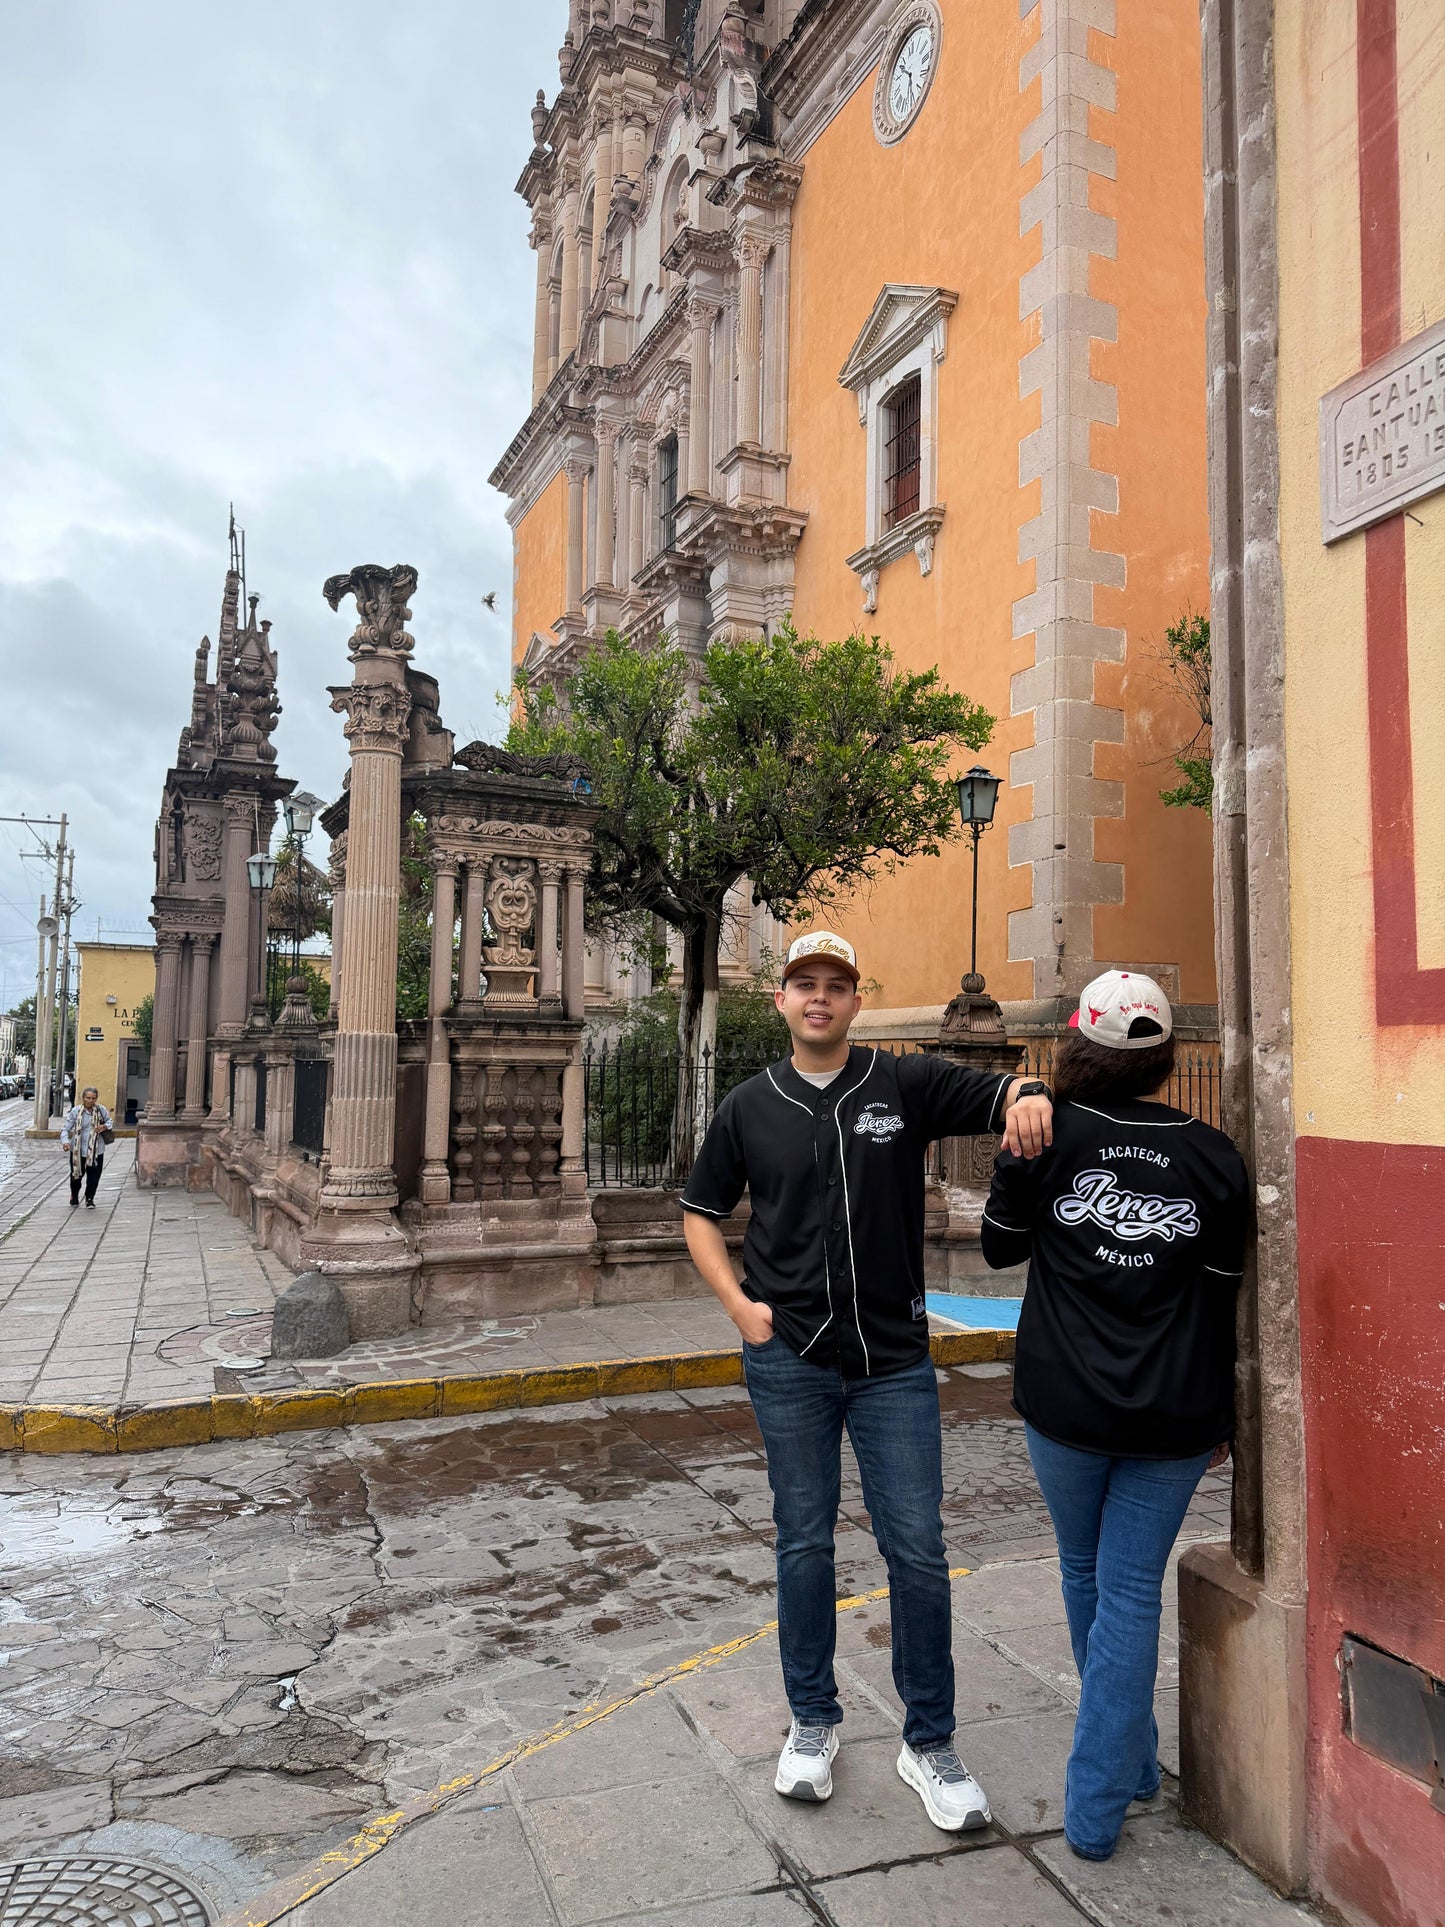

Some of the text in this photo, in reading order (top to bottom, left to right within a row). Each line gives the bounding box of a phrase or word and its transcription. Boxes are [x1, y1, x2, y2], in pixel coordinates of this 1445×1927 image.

[1368, 353, 1445, 419] CALLE
[1343, 388, 1445, 467] SANTUA
[1355, 444, 1409, 492] 1805
[114, 1008, 128, 1018] LA
[854, 1112, 904, 1135] Jerez
[1099, 1146, 1170, 1168] ZACATECAS
[1054, 1169, 1200, 1241] Jerez
[1095, 1245, 1154, 1267] MÉXICO
